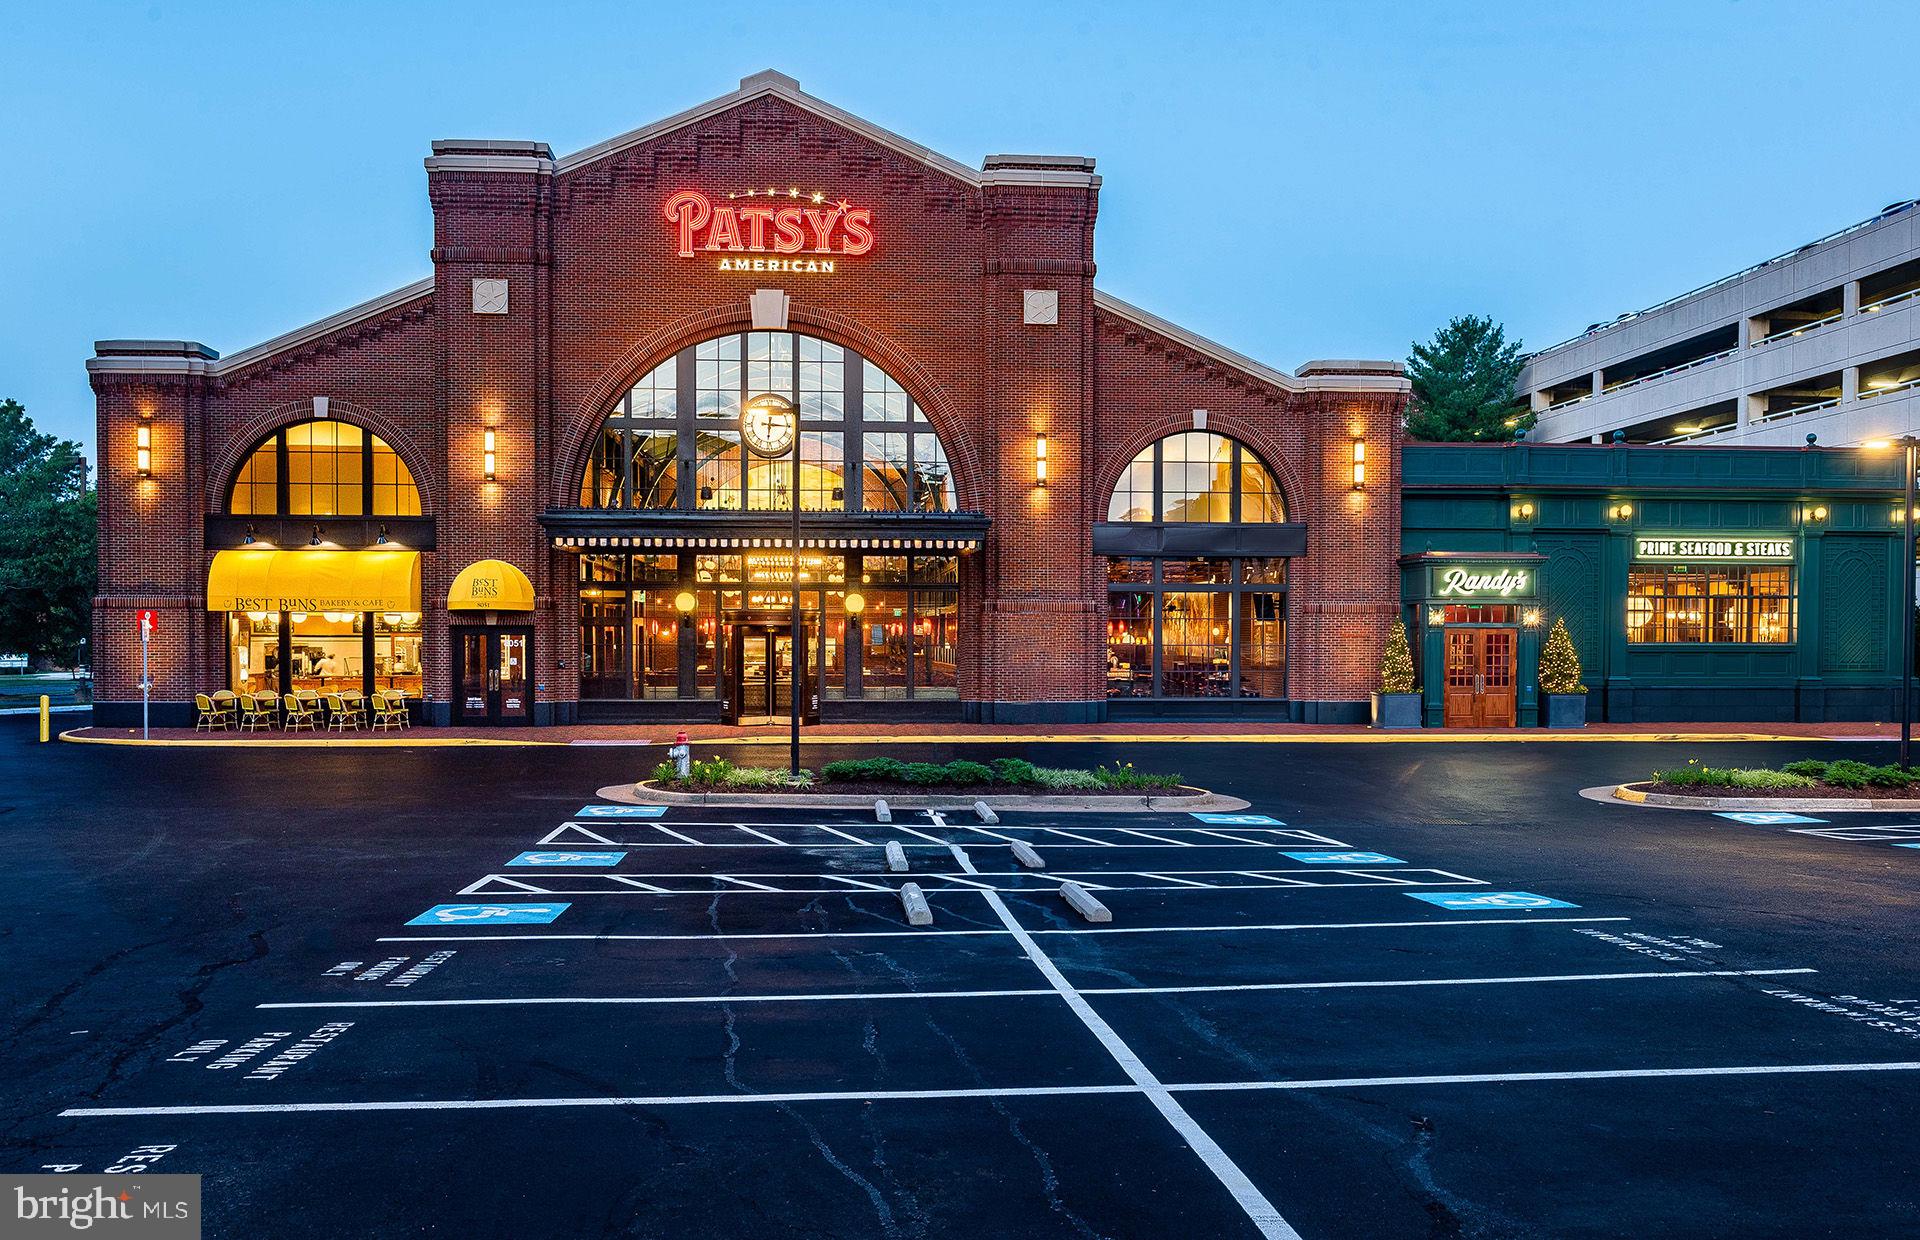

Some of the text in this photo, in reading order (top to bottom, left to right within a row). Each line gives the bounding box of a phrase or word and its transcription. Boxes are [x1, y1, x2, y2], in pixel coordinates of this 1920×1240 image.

[719, 259, 834, 273] AMERICAN
[1639, 541, 1790, 557] PRIME SEAFOOD & STEAKS
[1439, 568, 1528, 597] Randy's
[165, 1039, 229, 1062] ONLY
[206, 1031, 292, 1070] PARKING
[243, 1022, 356, 1081] RESTAURANT
